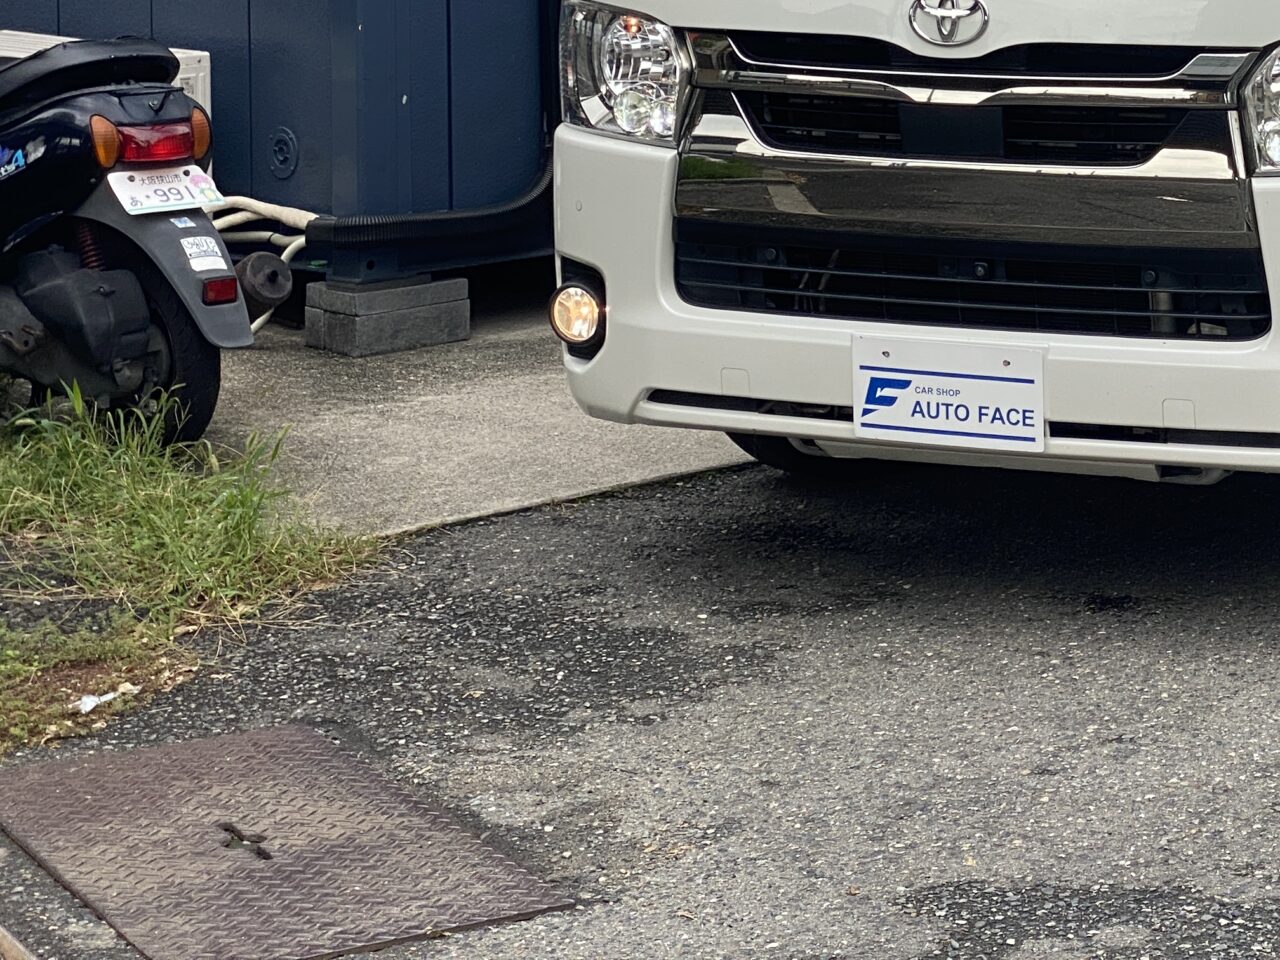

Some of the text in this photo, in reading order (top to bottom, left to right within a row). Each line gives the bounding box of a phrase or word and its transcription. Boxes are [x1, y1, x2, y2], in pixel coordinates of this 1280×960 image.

[914, 386, 961, 397] CAR SHOP
[911, 400, 1035, 428] AUTO FACE
